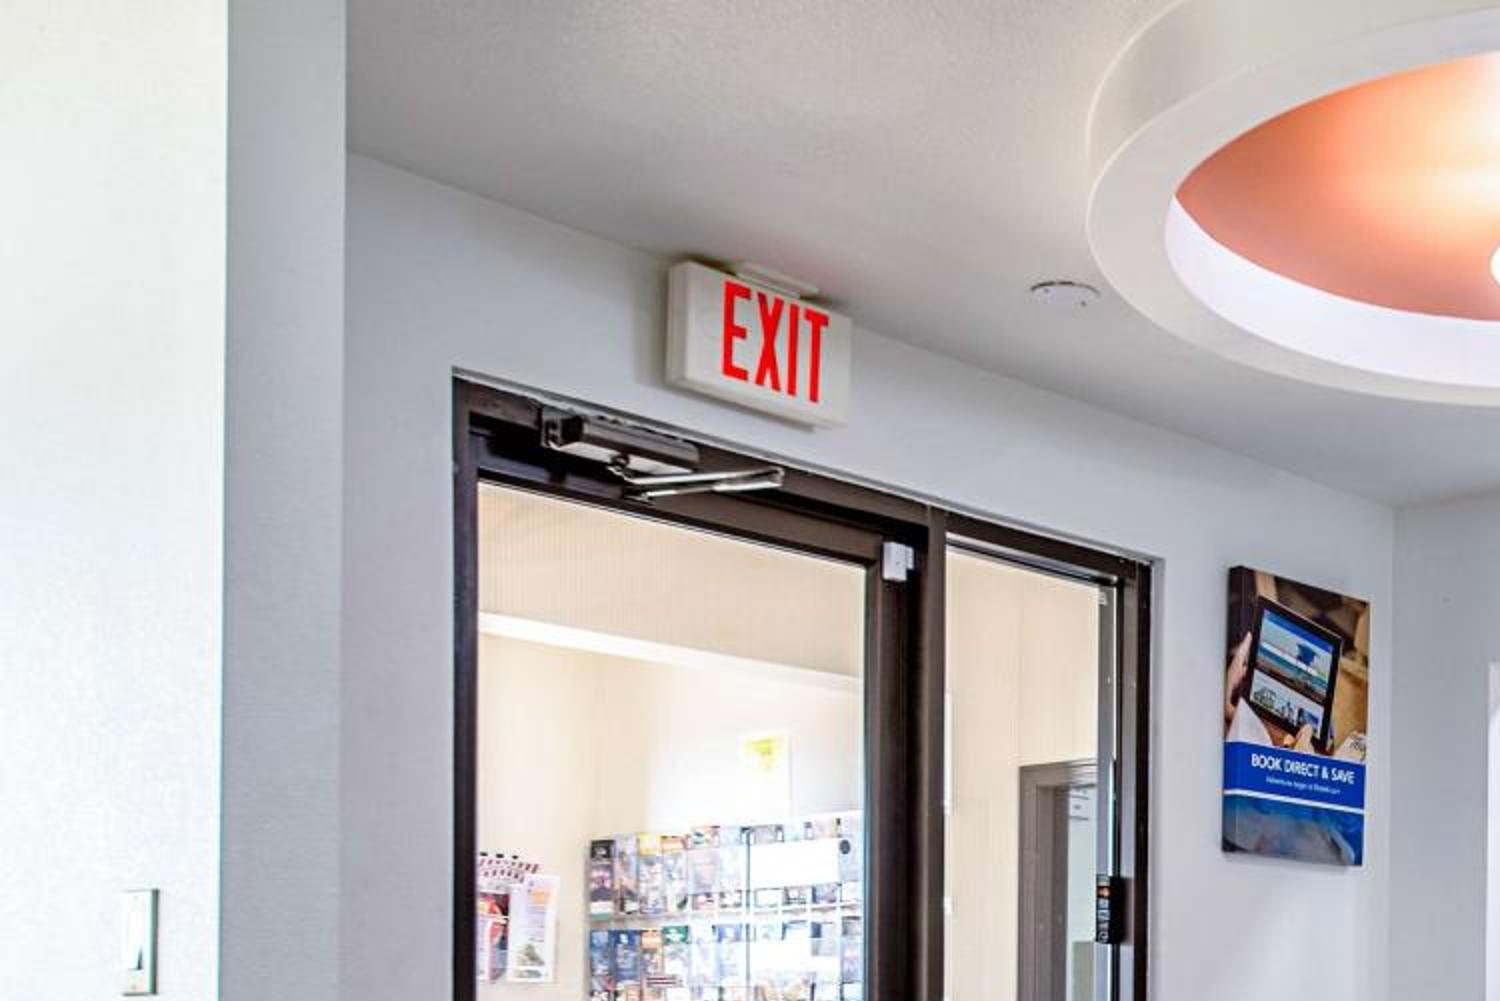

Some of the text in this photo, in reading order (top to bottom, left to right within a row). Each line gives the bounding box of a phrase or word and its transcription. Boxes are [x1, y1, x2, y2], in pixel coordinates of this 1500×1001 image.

[722, 280, 830, 404] EXIT
[1251, 753, 1282, 771] BOOK
[1283, 759, 1320, 778] DIRECT
[1331, 768, 1355, 785] SAVE
